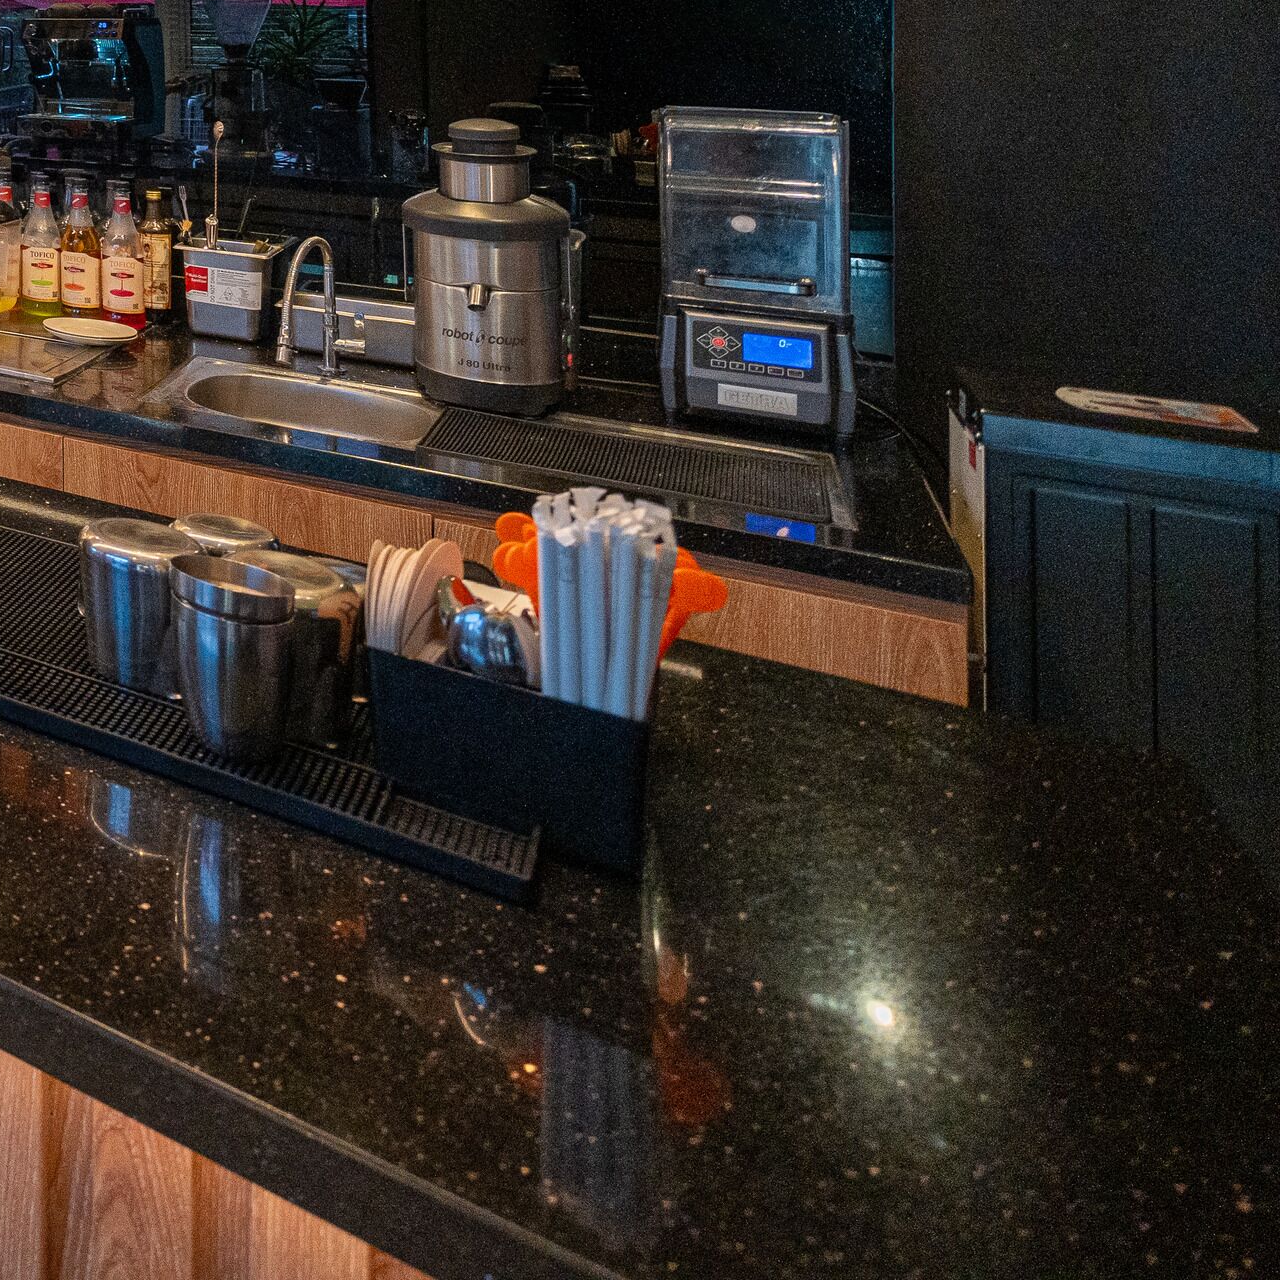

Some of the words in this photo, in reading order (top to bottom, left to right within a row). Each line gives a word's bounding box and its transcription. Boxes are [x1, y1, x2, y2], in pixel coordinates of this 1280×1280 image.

[30, 250, 55, 260] TOFICO
[441, 327, 474, 342] robot
[488, 334, 529, 347] coupe
[457, 358, 464, 366] J
[466, 359, 480, 369] 80
[482, 361, 511, 372] Ultra
